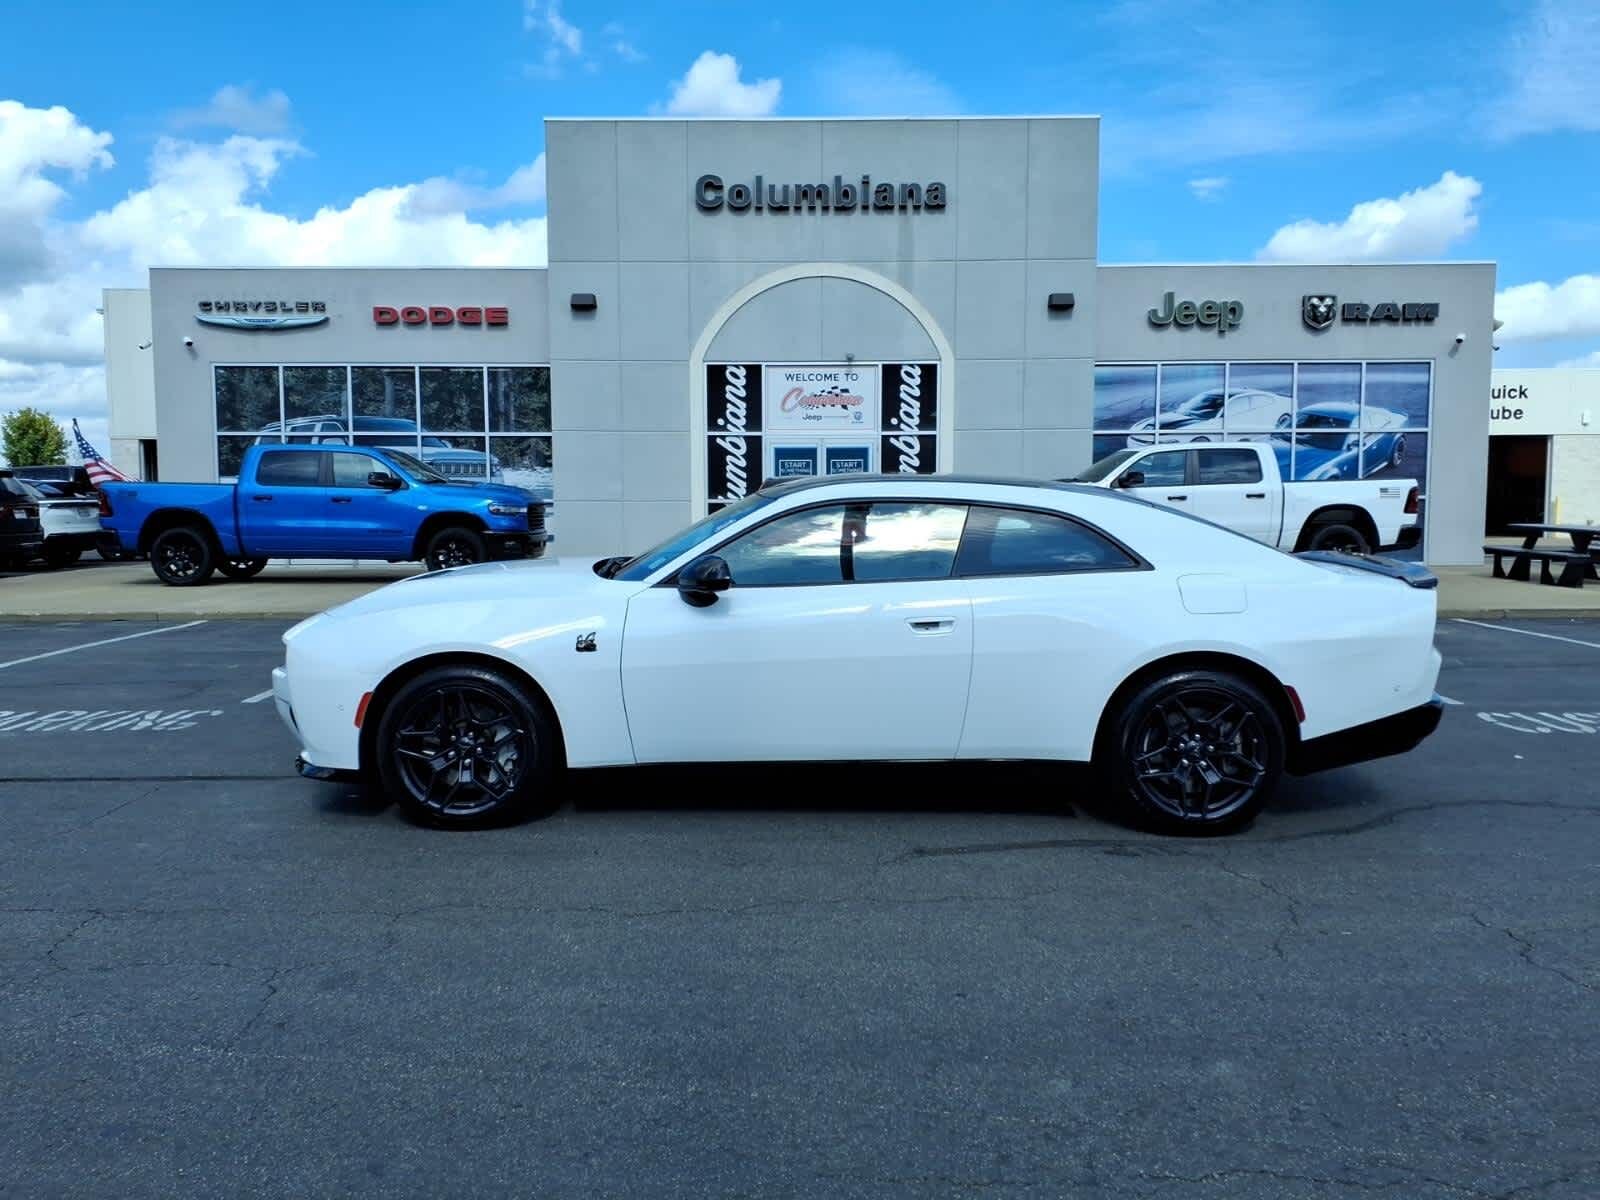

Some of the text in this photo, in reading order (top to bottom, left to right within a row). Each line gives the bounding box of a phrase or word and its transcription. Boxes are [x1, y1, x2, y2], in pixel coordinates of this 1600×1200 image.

[696, 174, 947, 211] Columbiana
[198, 301, 326, 312] CHRYSLER
[1148, 291, 1244, 332] Jeep
[1341, 303, 1440, 322] RAM
[373, 306, 508, 325] DODGE
[785, 373, 858, 381] WELCOME TO
[1491, 385, 1528, 399] uick
[1490, 406, 1523, 420] ube
